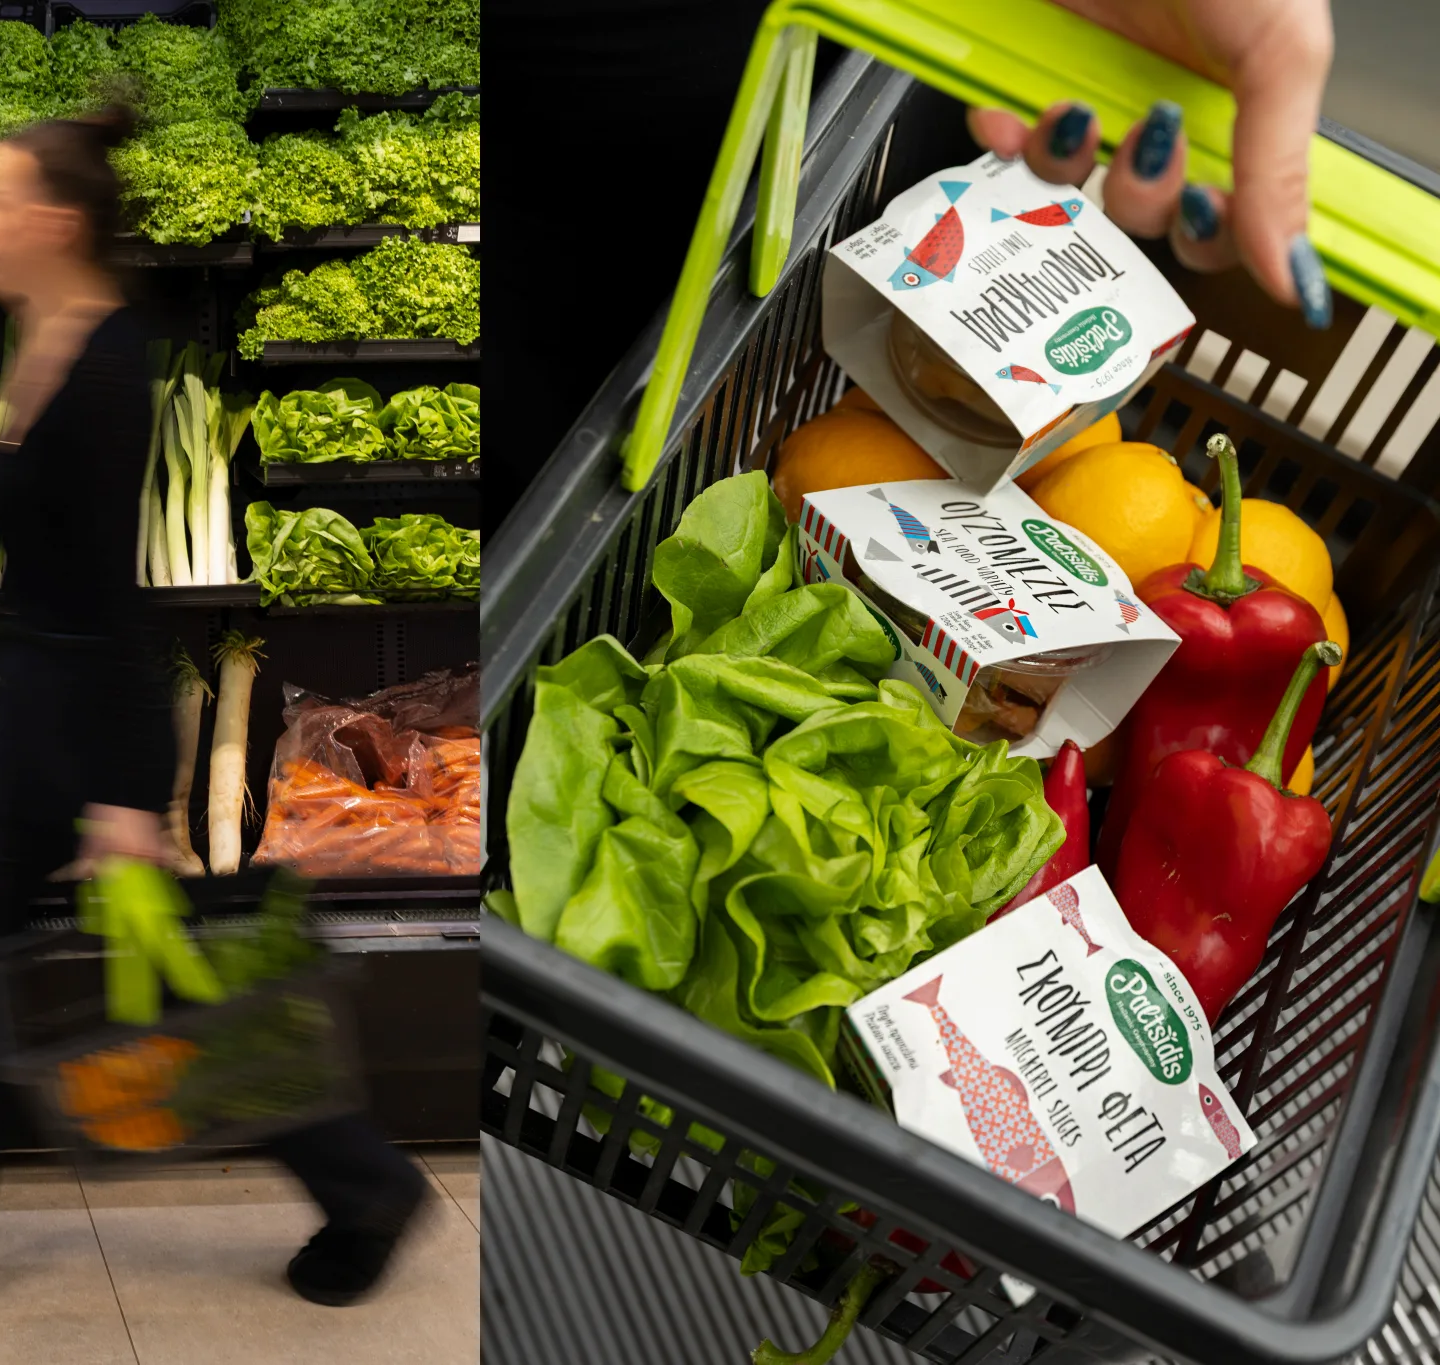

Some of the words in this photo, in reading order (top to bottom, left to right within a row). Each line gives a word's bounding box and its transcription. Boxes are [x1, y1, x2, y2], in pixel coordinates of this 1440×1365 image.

[999, 230, 1034, 257] TUNA
[1049, 310, 1125, 369] Paltsidis
[933, 528, 958, 543] SEA
[947, 544, 981, 564] FOOD
[940, 501, 1095, 615] ΟΥΖΟΜΕΖΕΣ
[1026, 523, 1098, 583] Paltsidis
[1110, 971, 1184, 1080] Paltsidis
[1163, 971, 1185, 1004] since
[1183, 1004, 1202, 1031] 1975
[1016, 949, 1111, 1092] ΣΚΟΥΜΠΡΙ
[1098, 1092, 1167, 1174] ΦΕΤΑ
